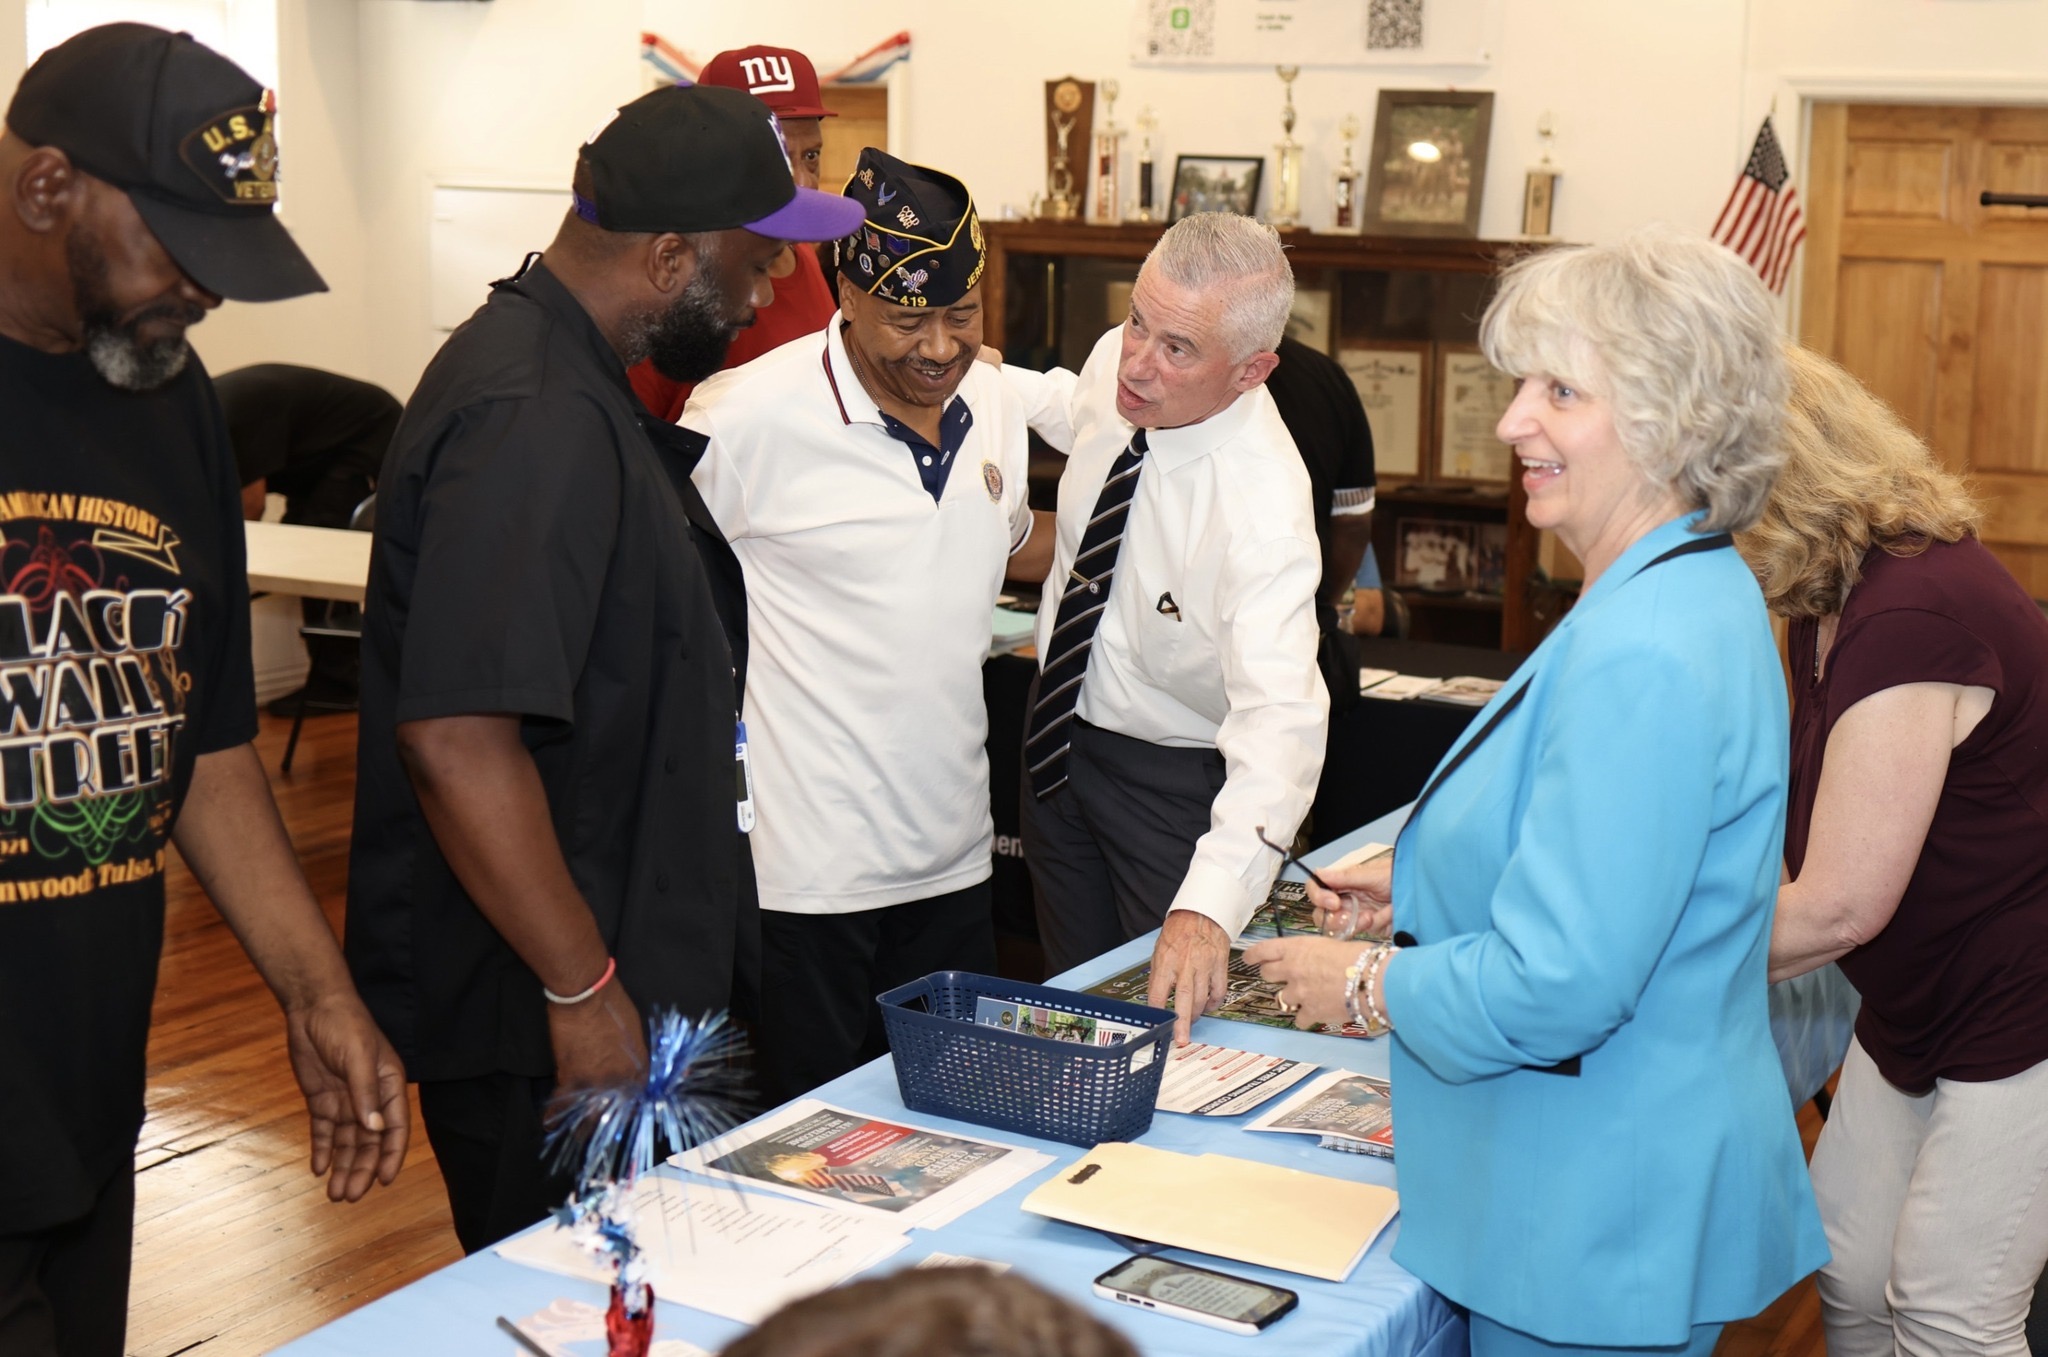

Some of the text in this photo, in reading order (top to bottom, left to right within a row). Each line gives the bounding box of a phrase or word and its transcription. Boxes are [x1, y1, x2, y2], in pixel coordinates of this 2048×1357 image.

[202, 114, 256, 152] U.S.
[900, 295, 927, 307] 419
[77, 496, 160, 538] HISTORY
